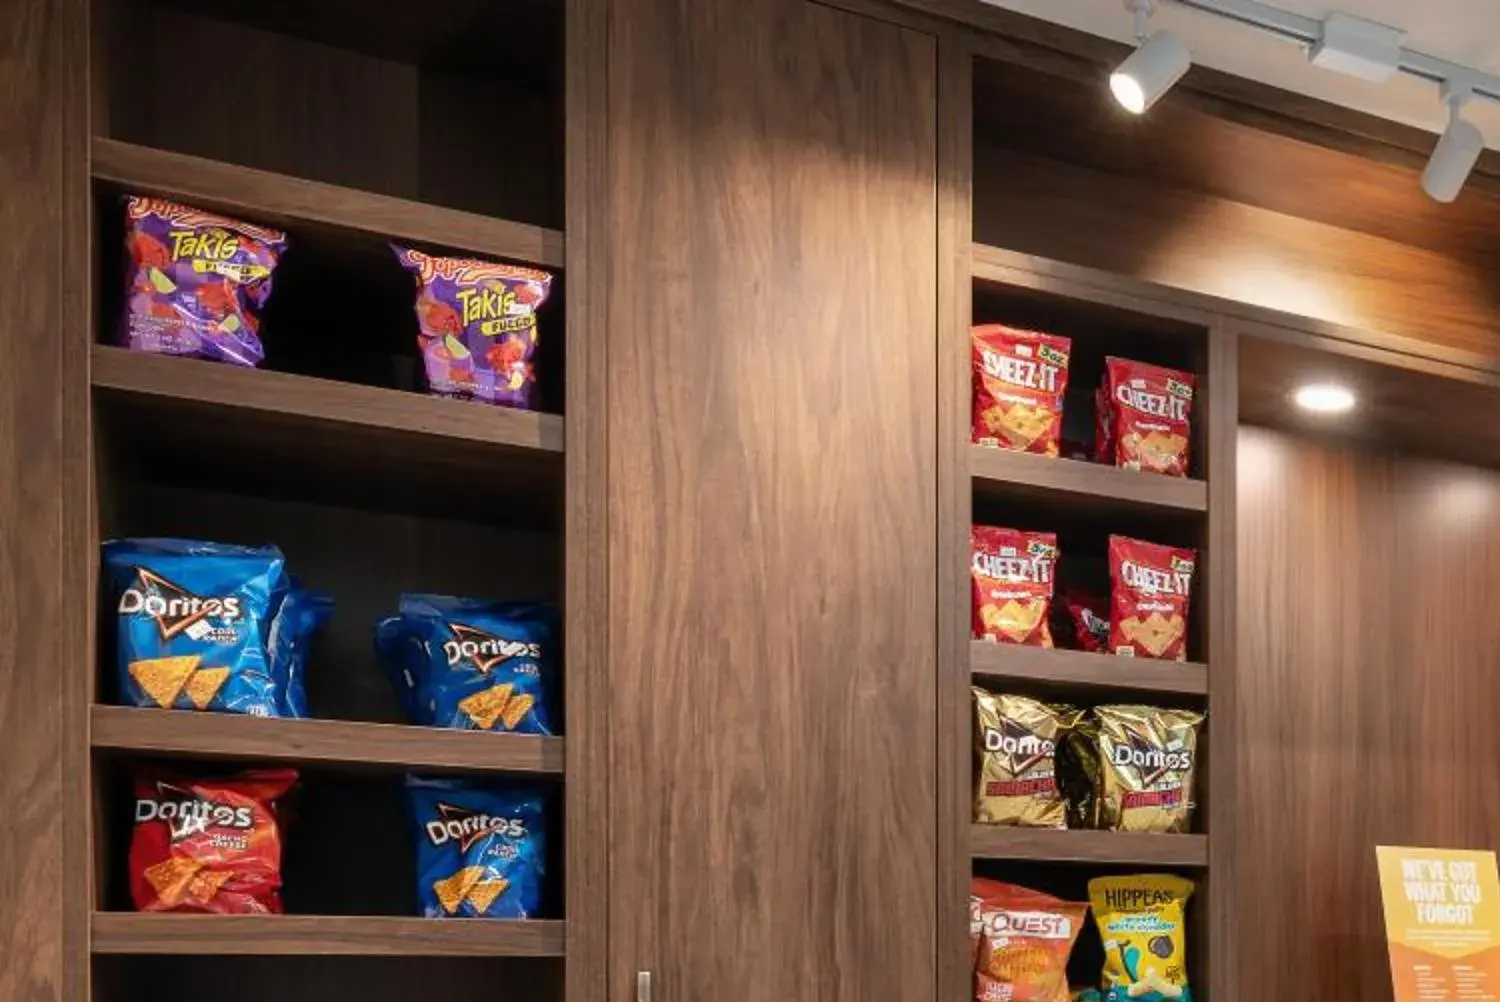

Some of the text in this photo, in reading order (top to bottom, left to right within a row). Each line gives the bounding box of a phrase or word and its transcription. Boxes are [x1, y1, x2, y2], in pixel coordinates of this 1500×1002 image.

[169, 229, 239, 262] Takis
[456, 288, 516, 327] Takis
[118, 589, 240, 618] Doritos
[443, 640, 541, 667] Doritos
[985, 729, 1056, 757] Dorito
[1114, 745, 1191, 770] Doritos
[136, 799, 253, 828] Doritos
[426, 814, 526, 846] Doritos
[1105, 887, 1174, 908] HIPPEAS
[991, 912, 1064, 936] QUEST
